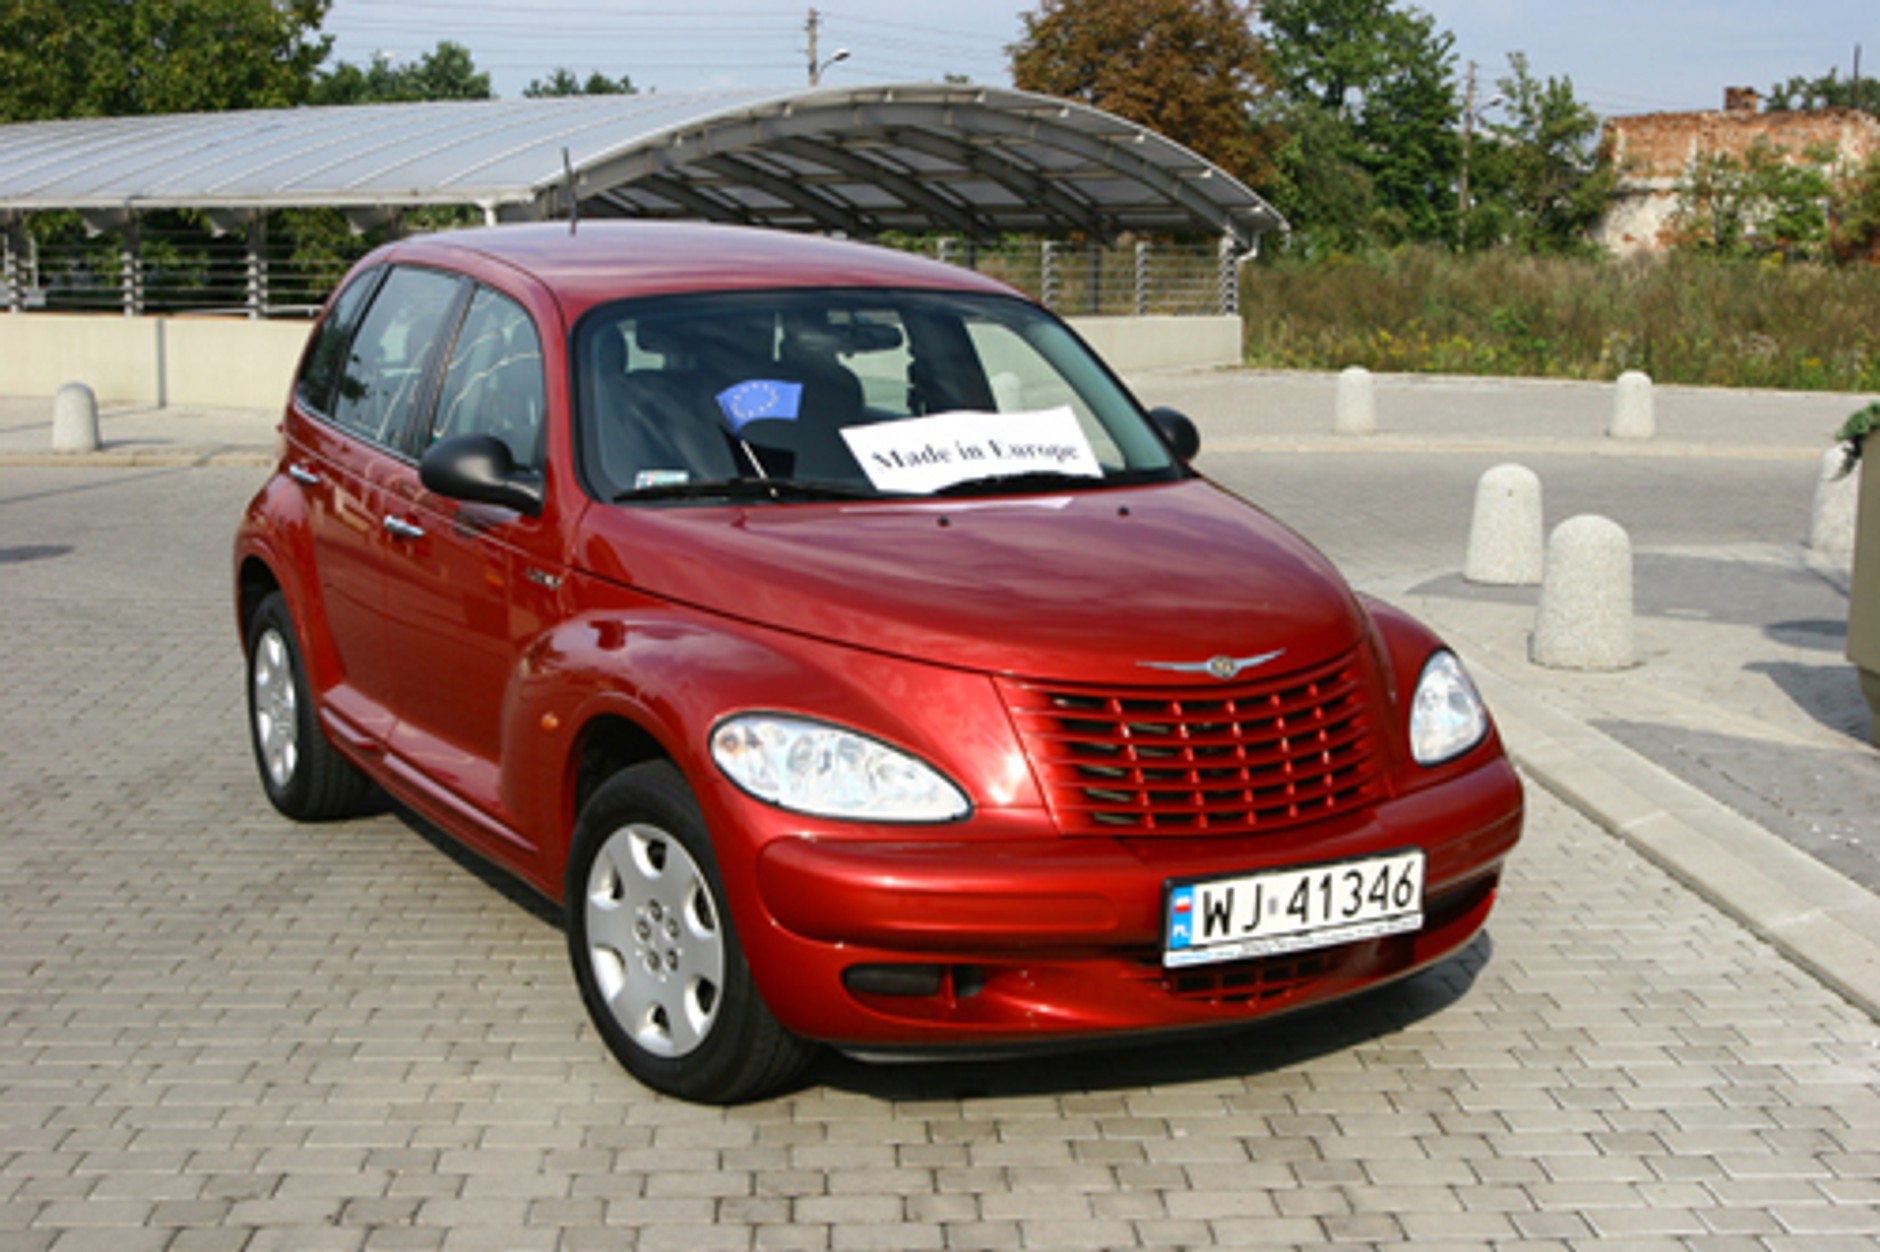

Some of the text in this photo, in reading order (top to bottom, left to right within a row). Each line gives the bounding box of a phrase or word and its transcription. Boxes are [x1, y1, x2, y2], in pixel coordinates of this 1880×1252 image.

[872, 439, 1080, 468] Made in Europe
[1203, 884, 1262, 937] WJ
[1286, 860, 1415, 924] 41346
